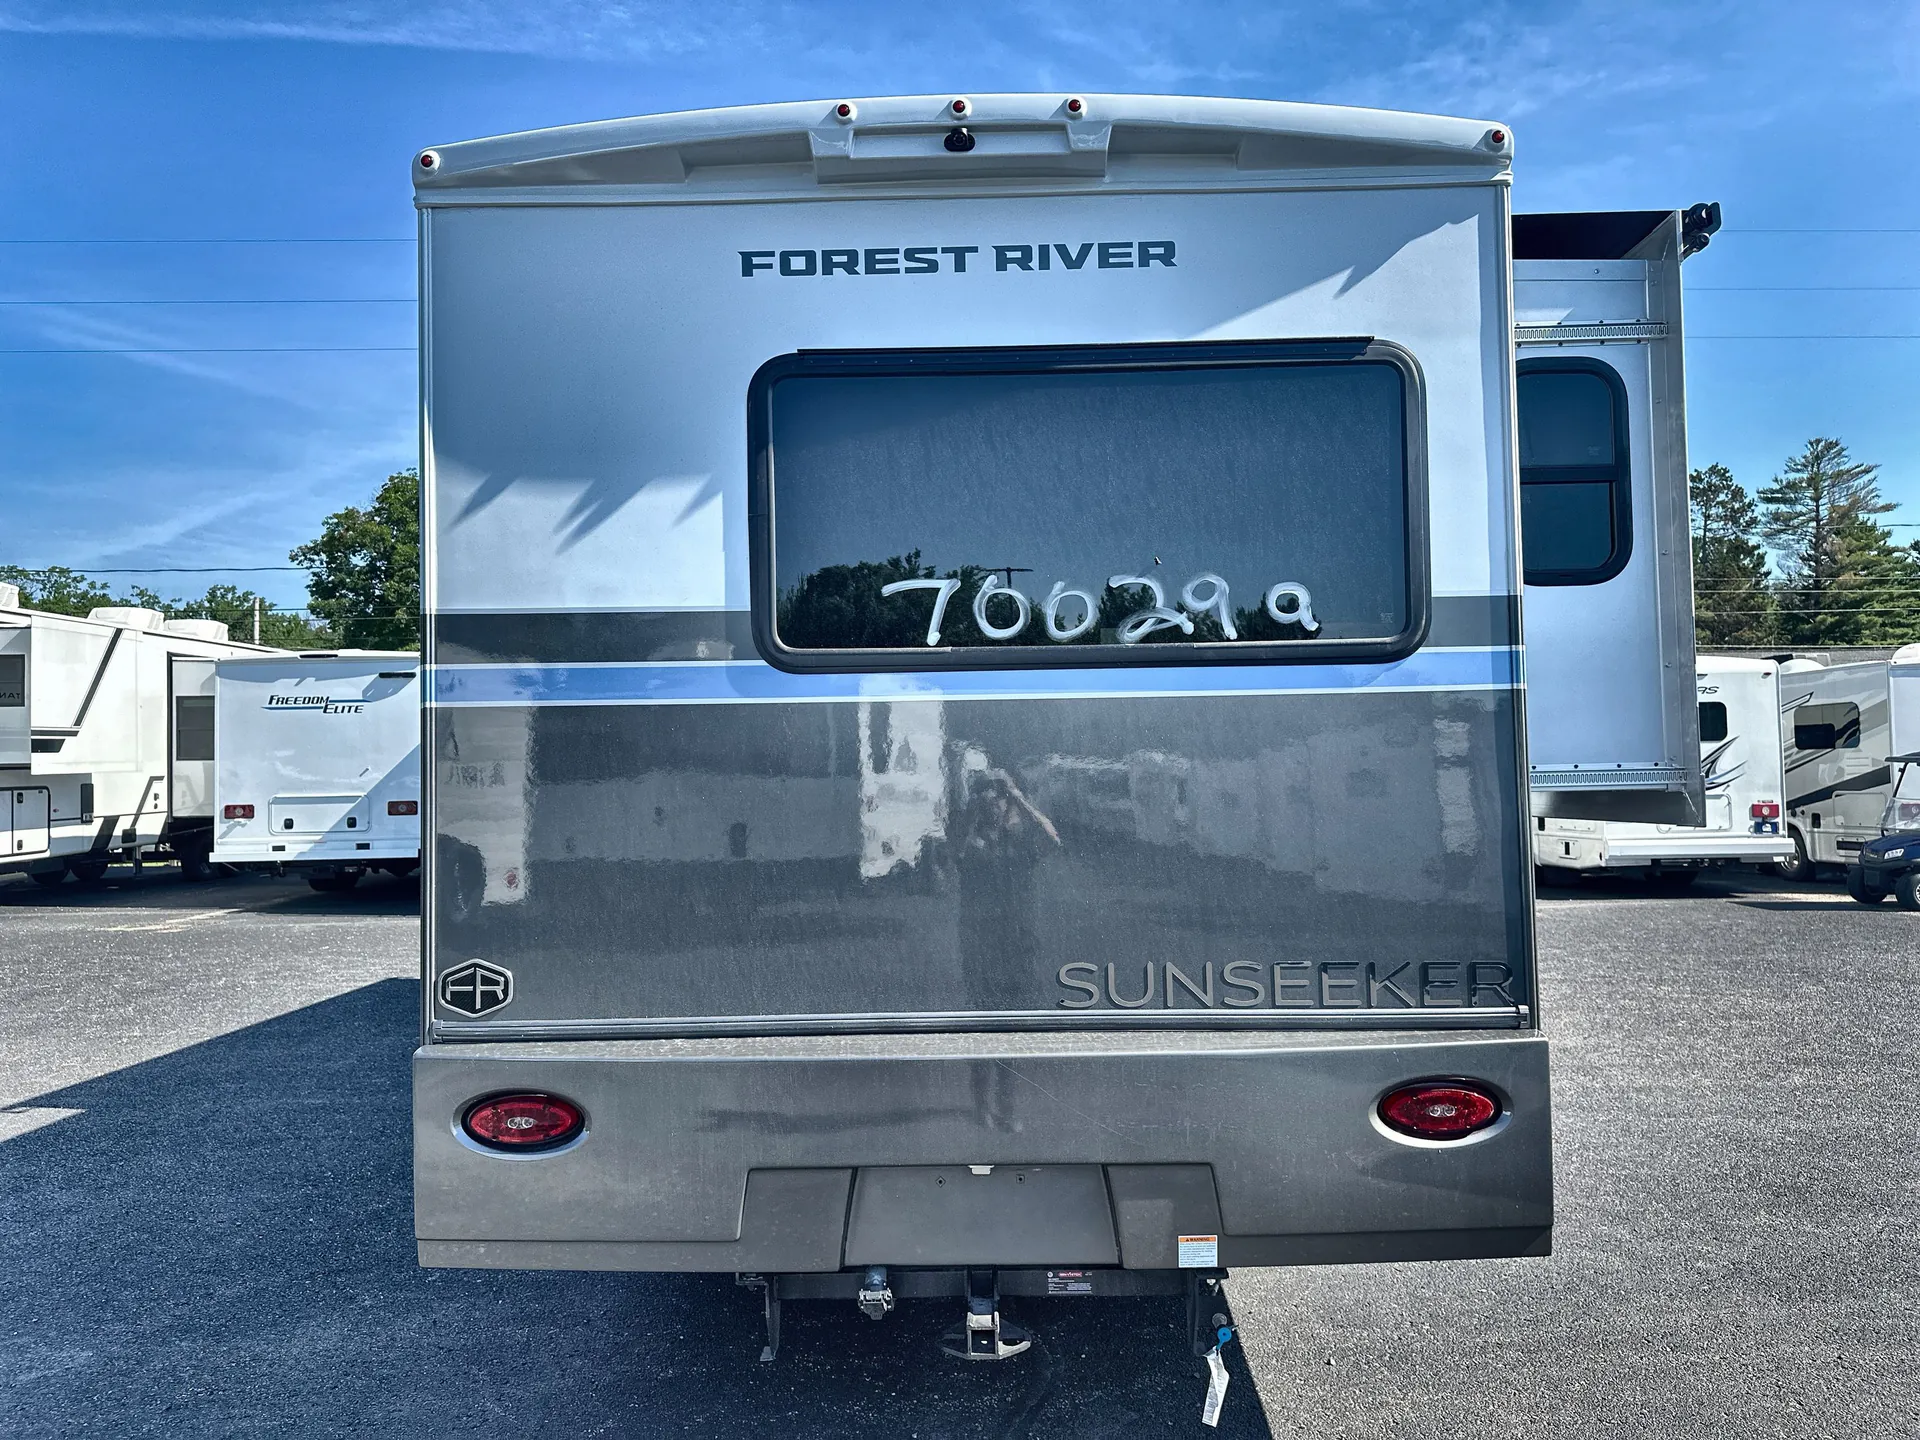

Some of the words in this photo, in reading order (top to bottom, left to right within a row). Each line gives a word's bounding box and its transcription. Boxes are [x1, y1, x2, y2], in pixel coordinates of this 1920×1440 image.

[737, 246, 979, 277] FOREST
[992, 240, 1177, 272] RIVER
[268, 695, 329, 706] FREEDOM
[322, 703, 364, 714] ELITE
[1057, 961, 1515, 1009] SUNSEEKER
